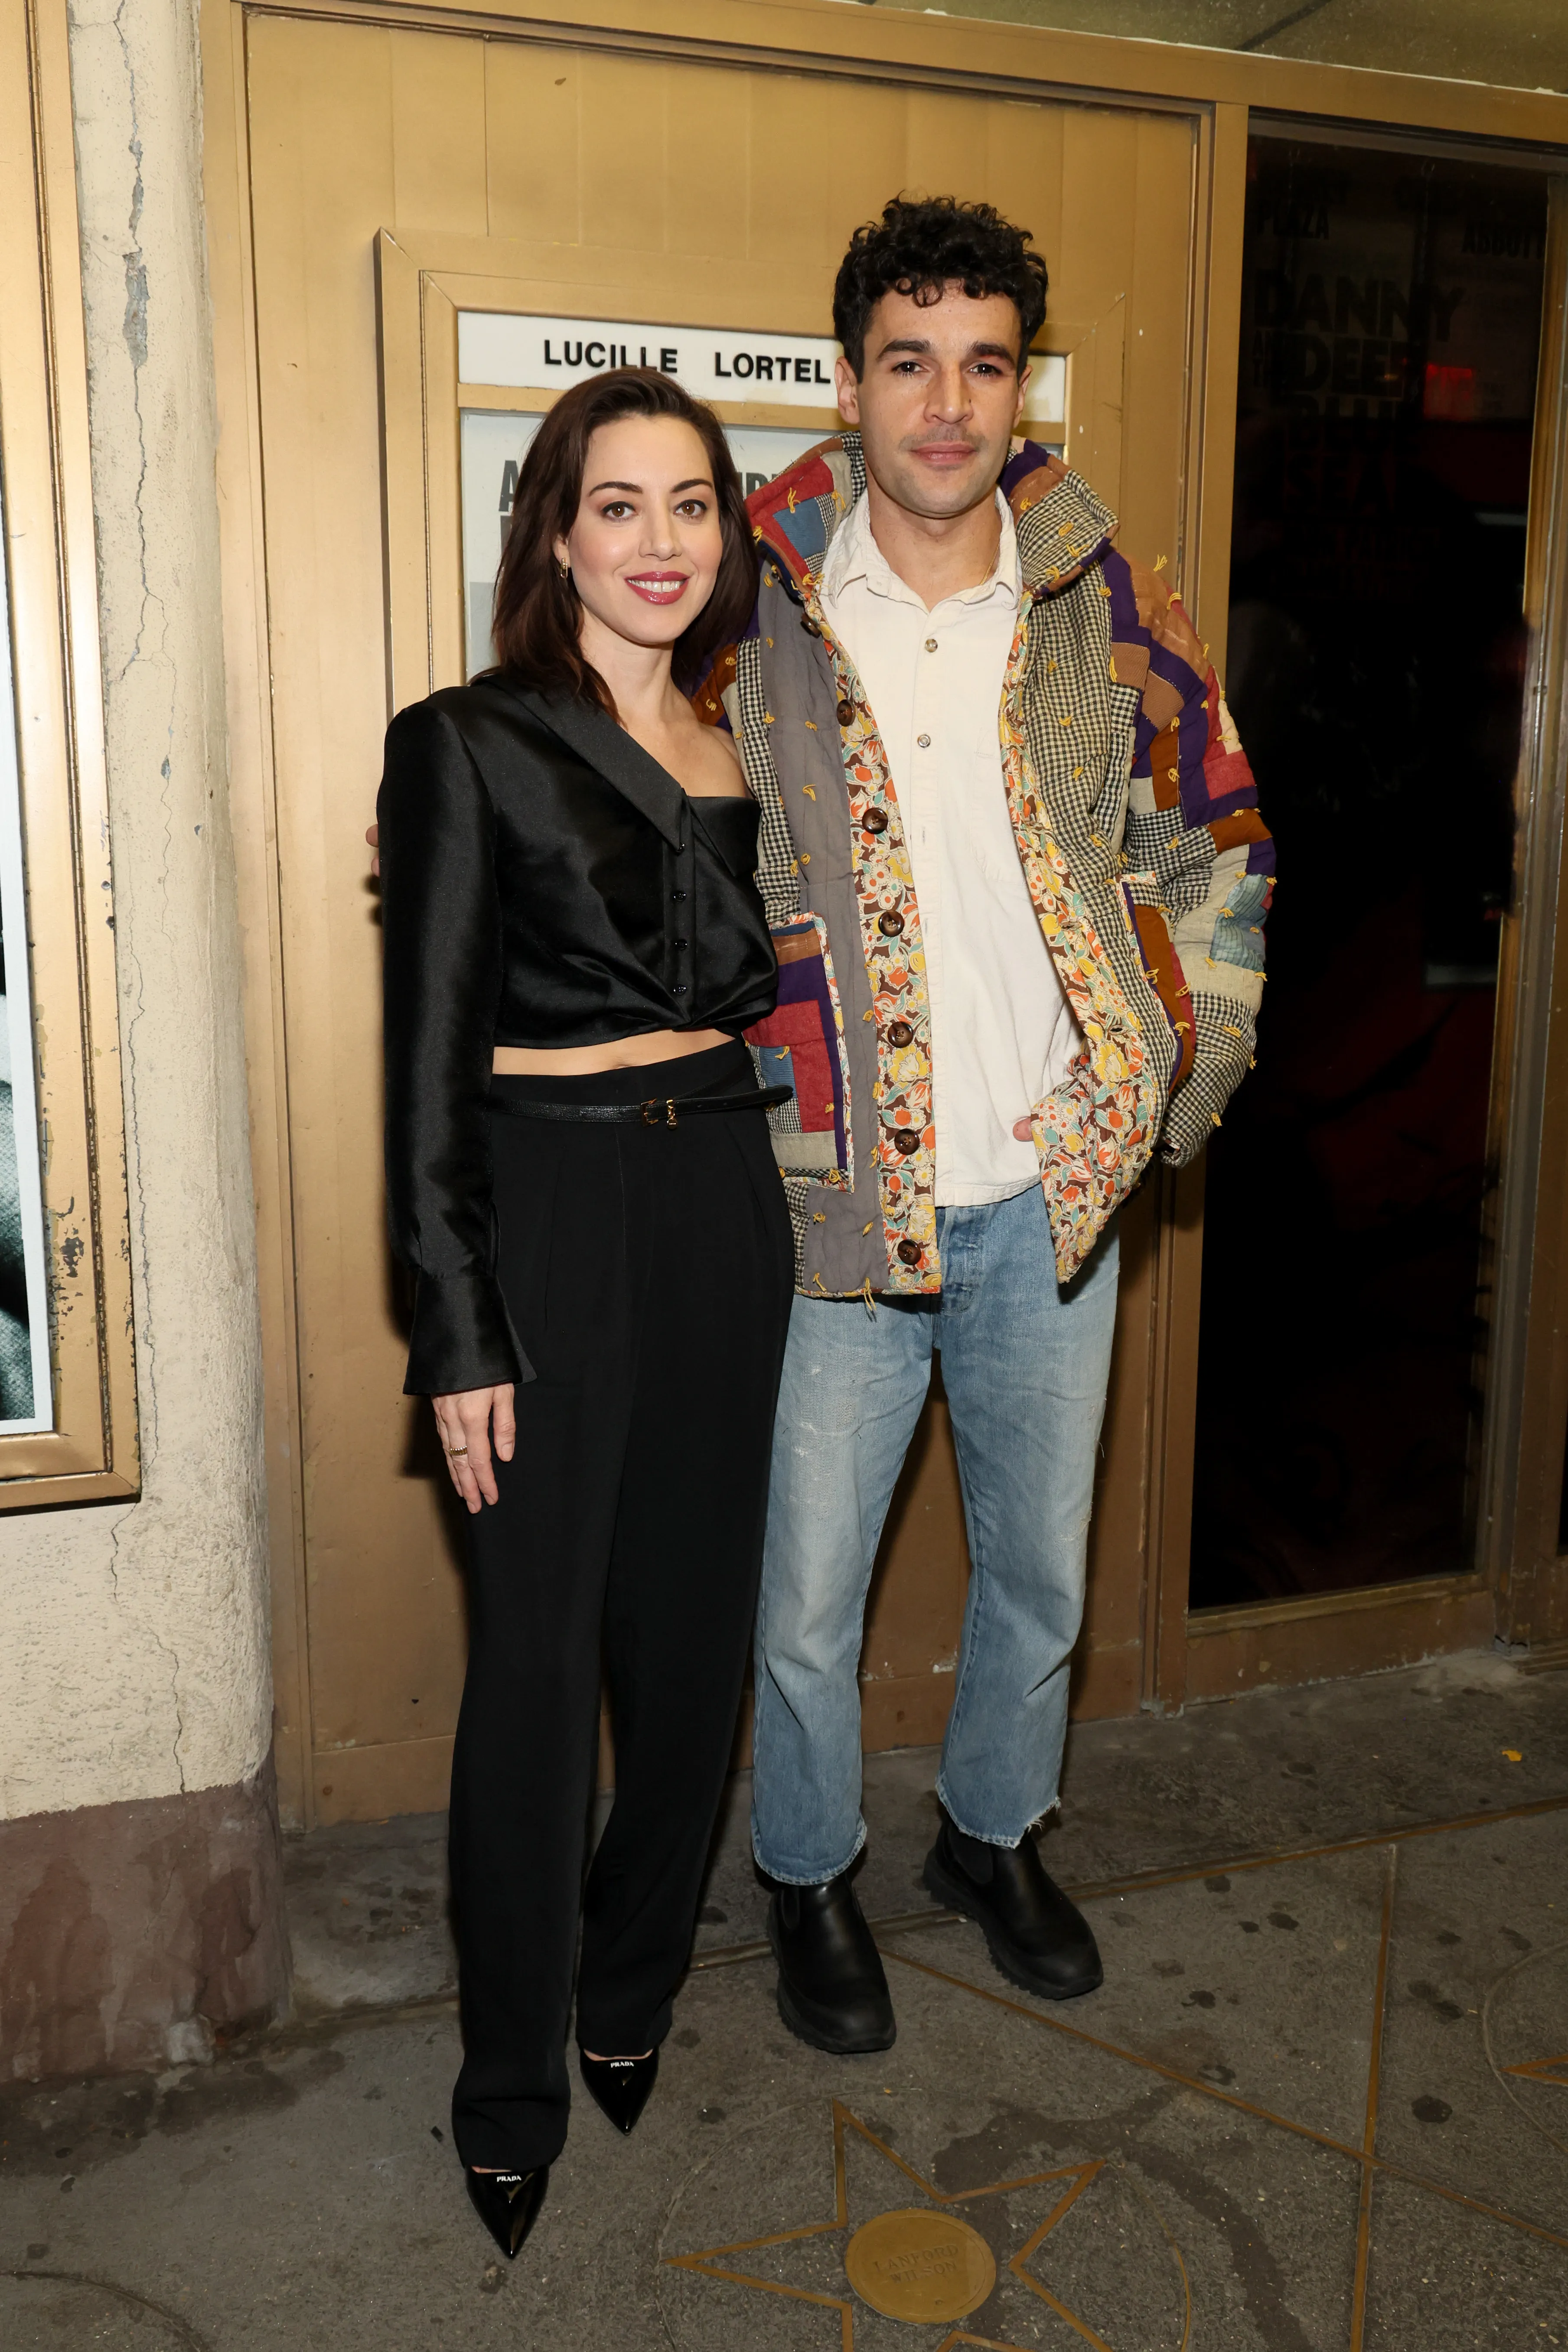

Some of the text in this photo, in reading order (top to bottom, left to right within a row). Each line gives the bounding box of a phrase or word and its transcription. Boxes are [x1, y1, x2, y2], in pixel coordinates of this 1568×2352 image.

[1257, 200, 1329, 240] PLAZA
[1254, 267, 1466, 342] DANNY
[544, 339, 831, 384] LUCILLE LORTEL
[872, 2244, 959, 2273] LANFORD
[889, 2261, 957, 2284] WILSON
